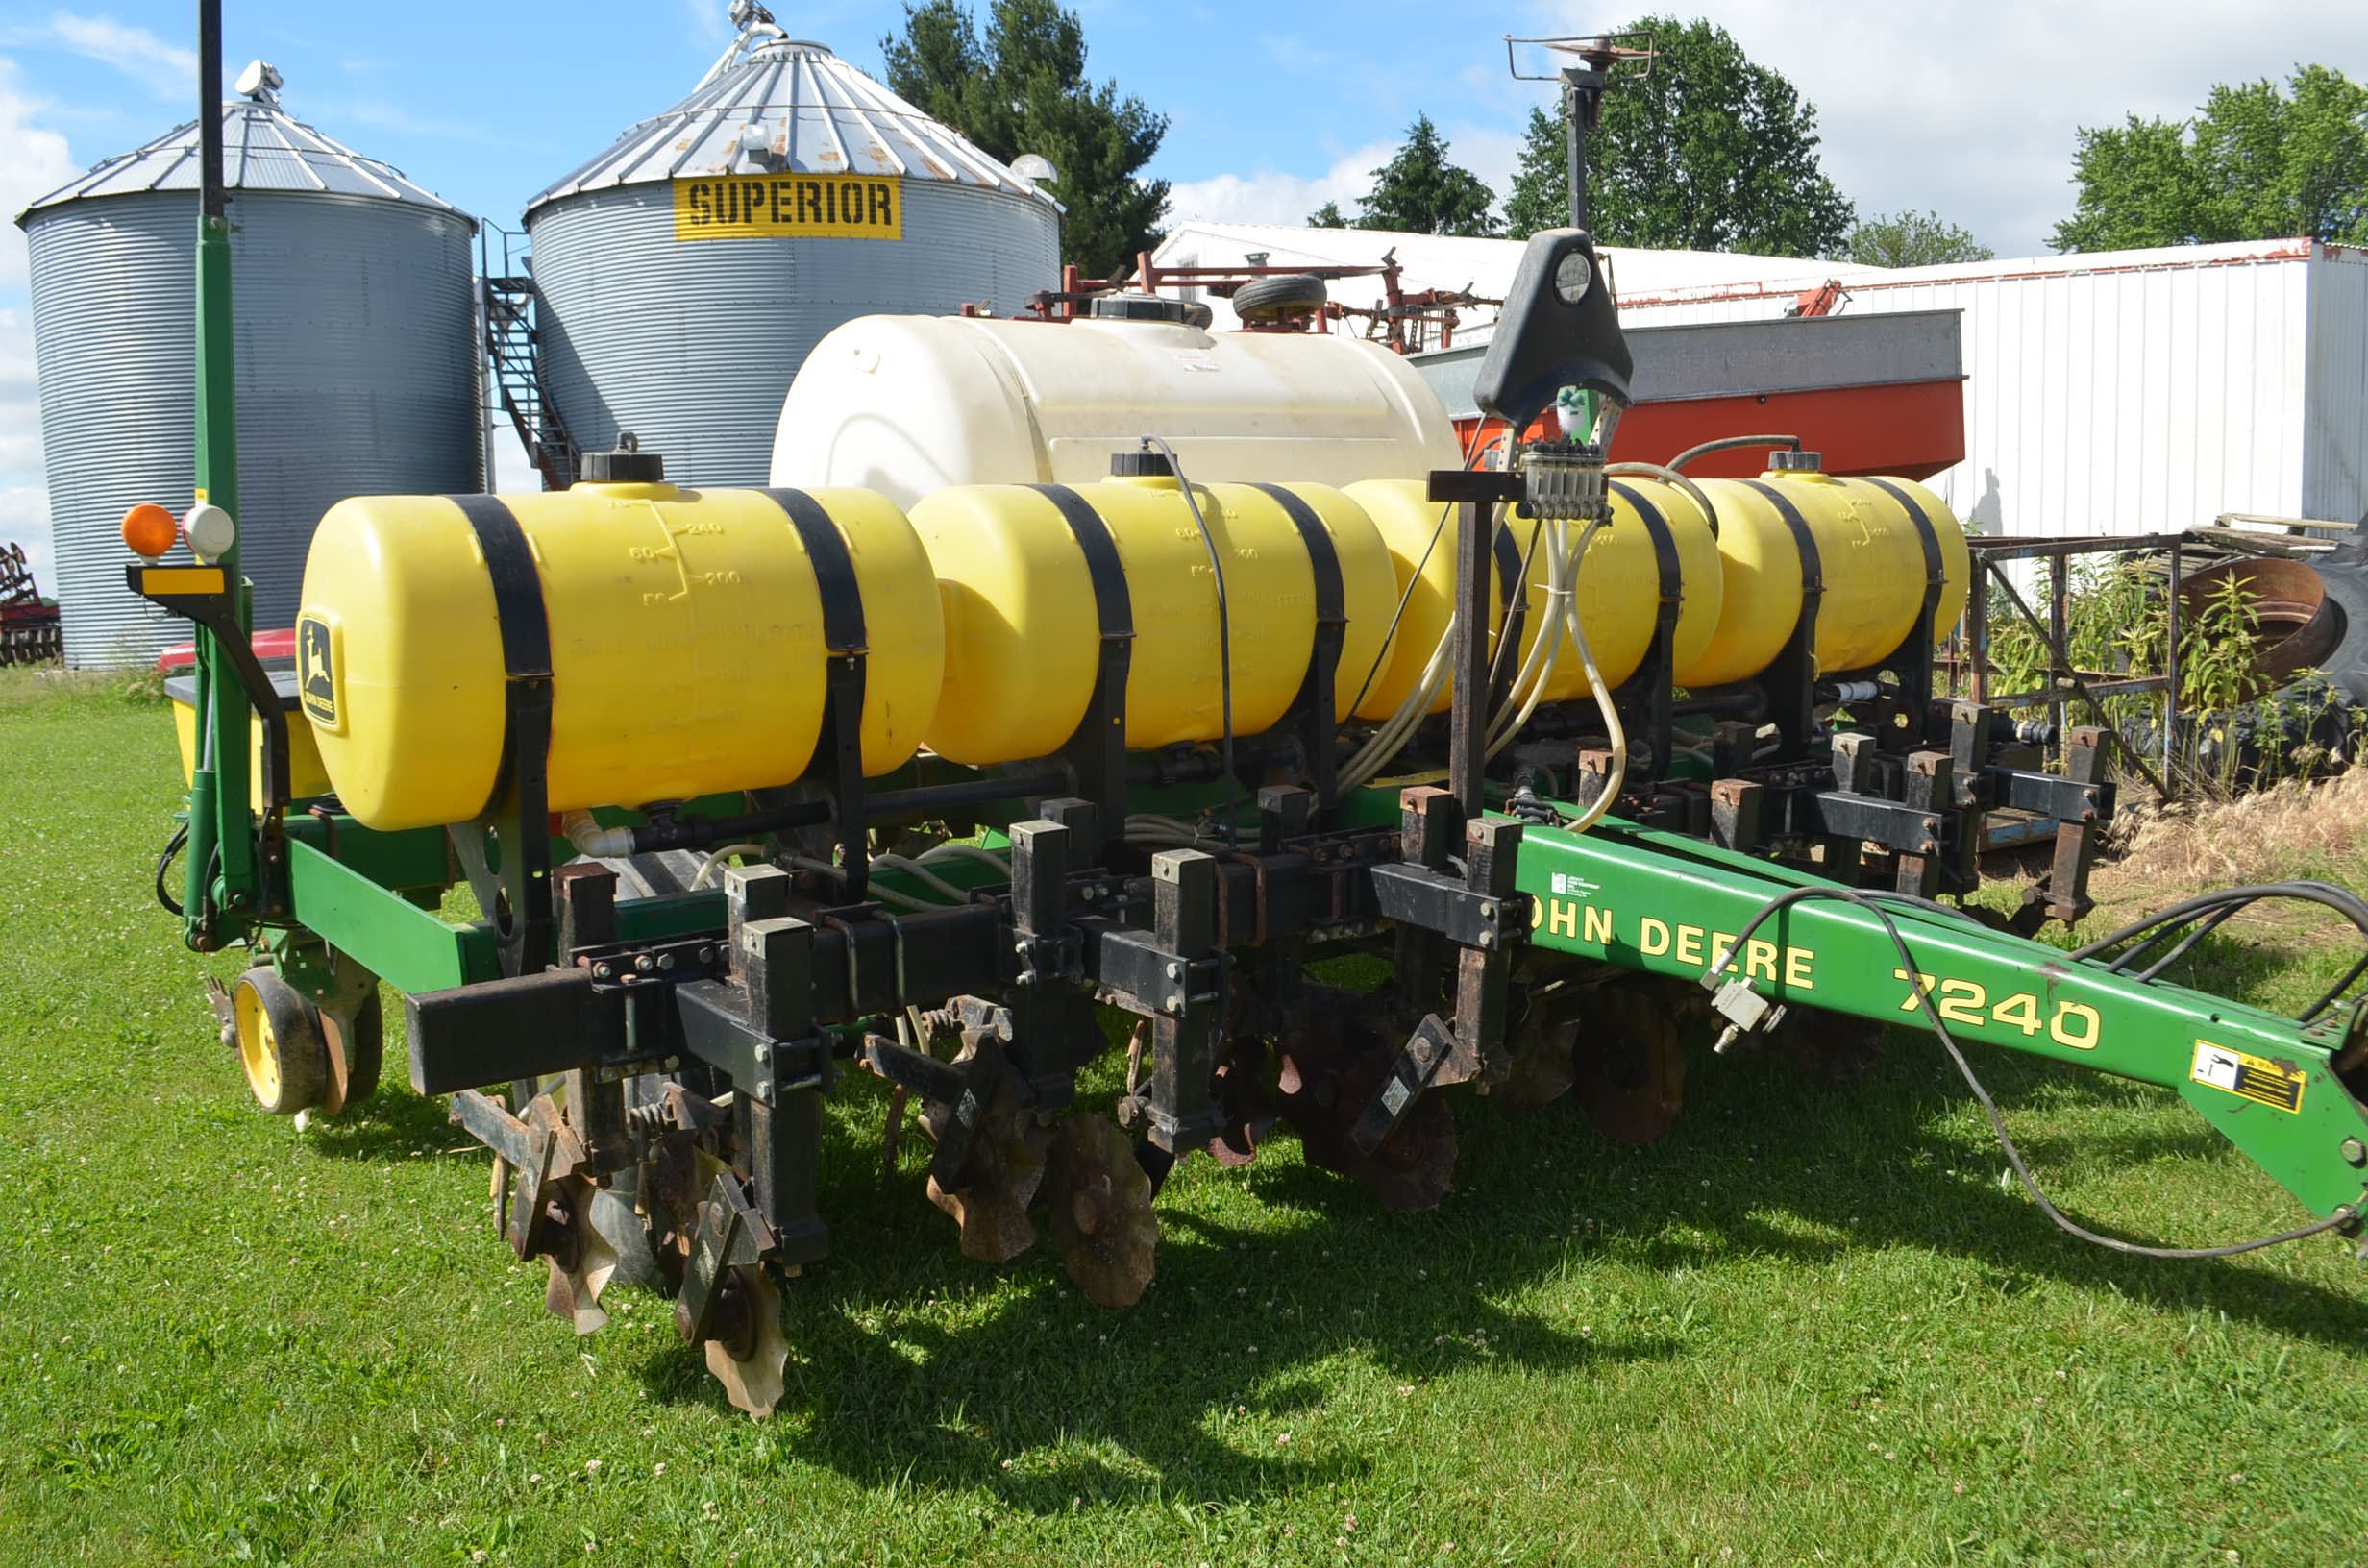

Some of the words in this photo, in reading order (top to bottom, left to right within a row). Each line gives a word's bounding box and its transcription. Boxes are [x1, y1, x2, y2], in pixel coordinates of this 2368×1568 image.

[689, 181, 893, 226] SUPERIOR
[1640, 916, 1814, 990] DEERE
[1893, 968, 2101, 1050] 7240
